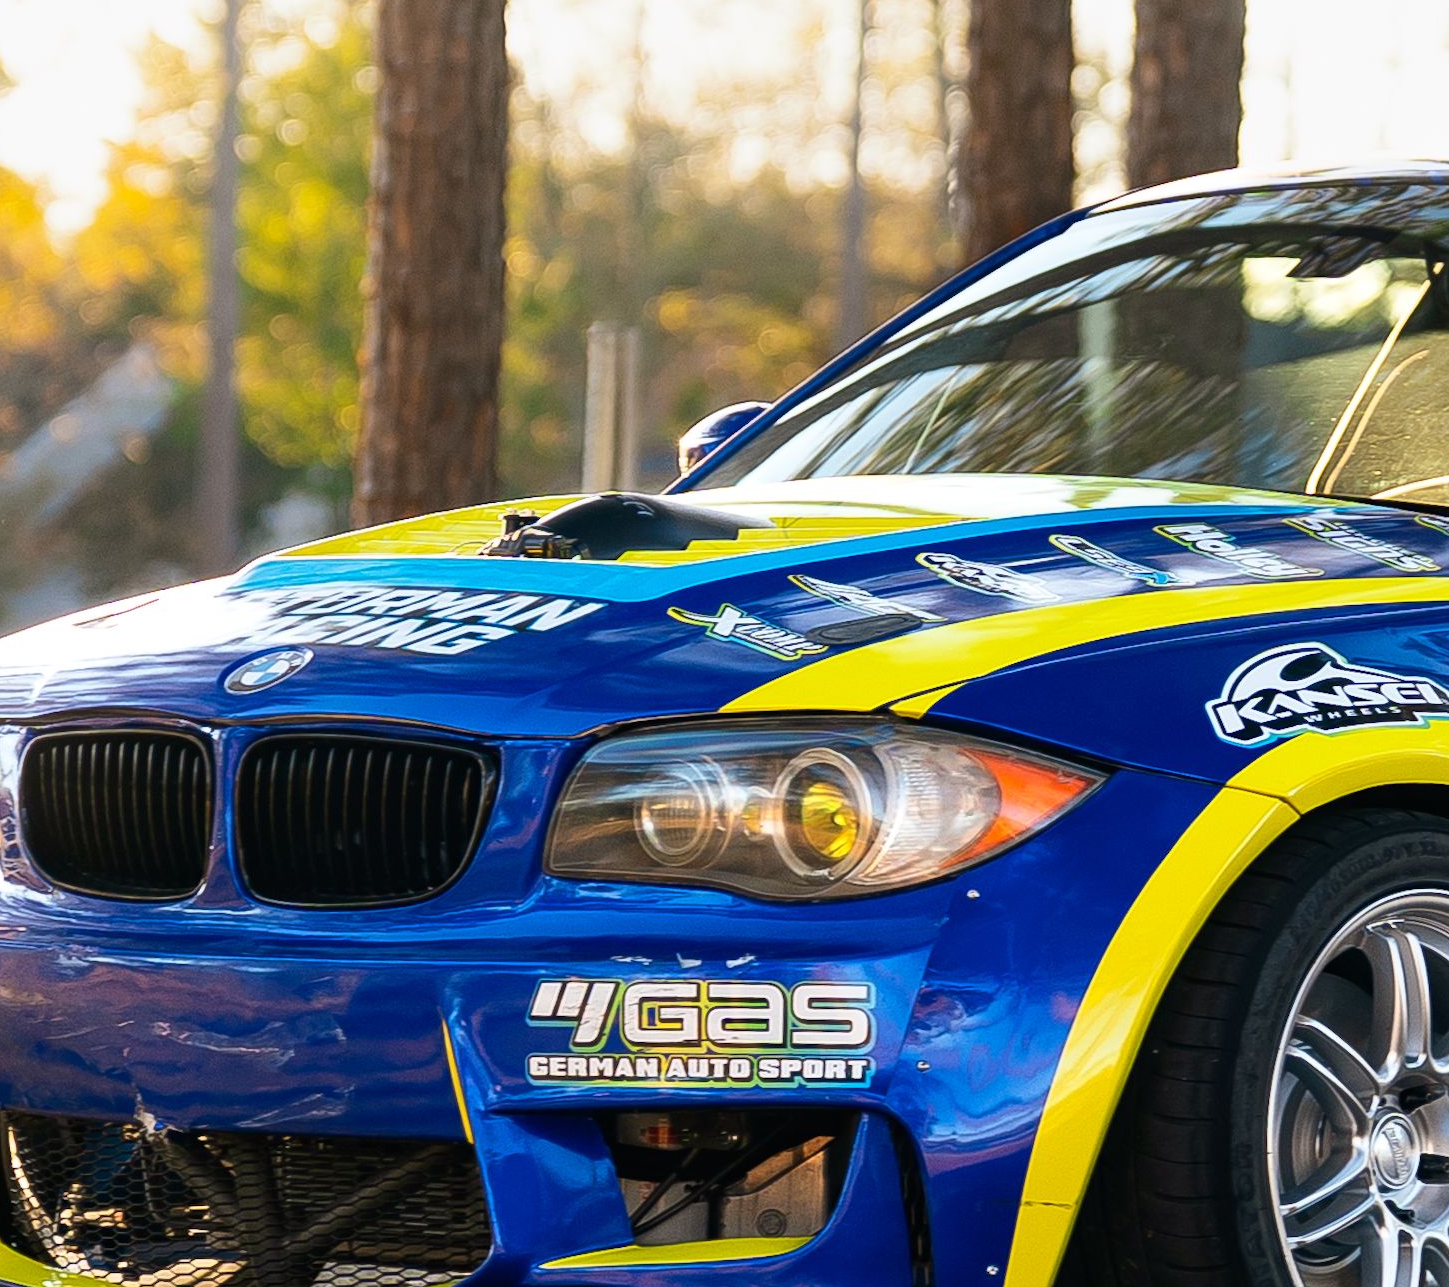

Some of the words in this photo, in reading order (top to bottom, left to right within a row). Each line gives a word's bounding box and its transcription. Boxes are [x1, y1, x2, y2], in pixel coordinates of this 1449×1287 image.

[1163, 523, 1311, 578] Holley
[219, 584, 609, 632] ATORMAN
[223, 614, 518, 655] ACING
[1216, 683, 1444, 734] KANSEI
[1303, 705, 1402, 723] WHEELS
[529, 1056, 660, 1079] GERMAN
[664, 1057, 752, 1080] AUTO
[757, 1058, 869, 1081] SPORT
